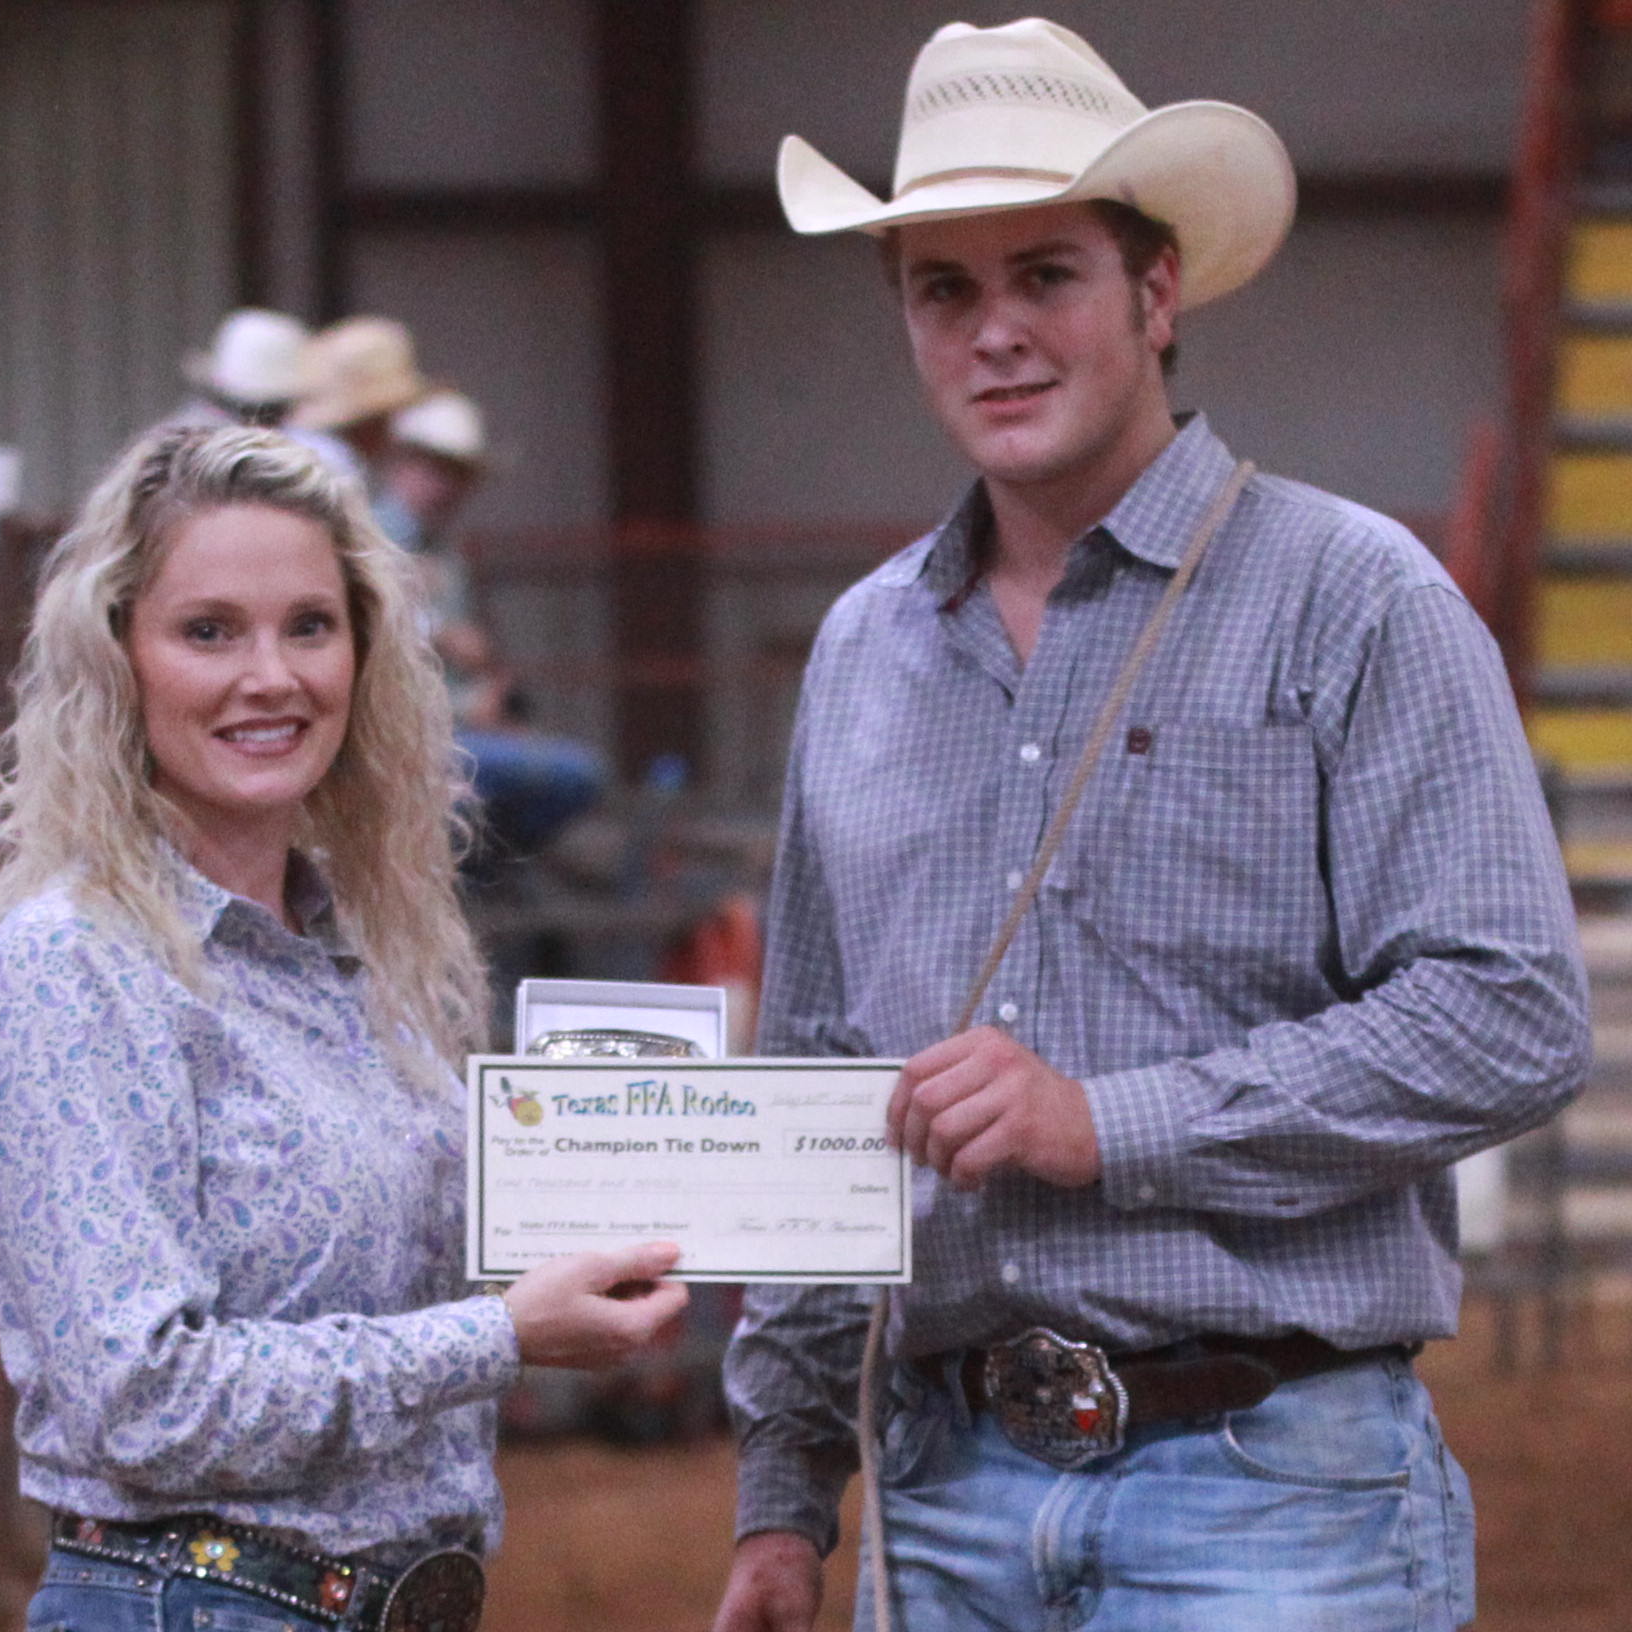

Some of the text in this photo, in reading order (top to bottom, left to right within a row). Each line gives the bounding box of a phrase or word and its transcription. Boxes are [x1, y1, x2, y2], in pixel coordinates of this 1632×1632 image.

[551, 1094, 619, 1116] Texas
[625, 1080, 674, 1116] FFA
[681, 1084, 757, 1117] Rodeo
[555, 1138, 761, 1156] Champion Tie Down
[794, 1136, 887, 1153] $1000.00
